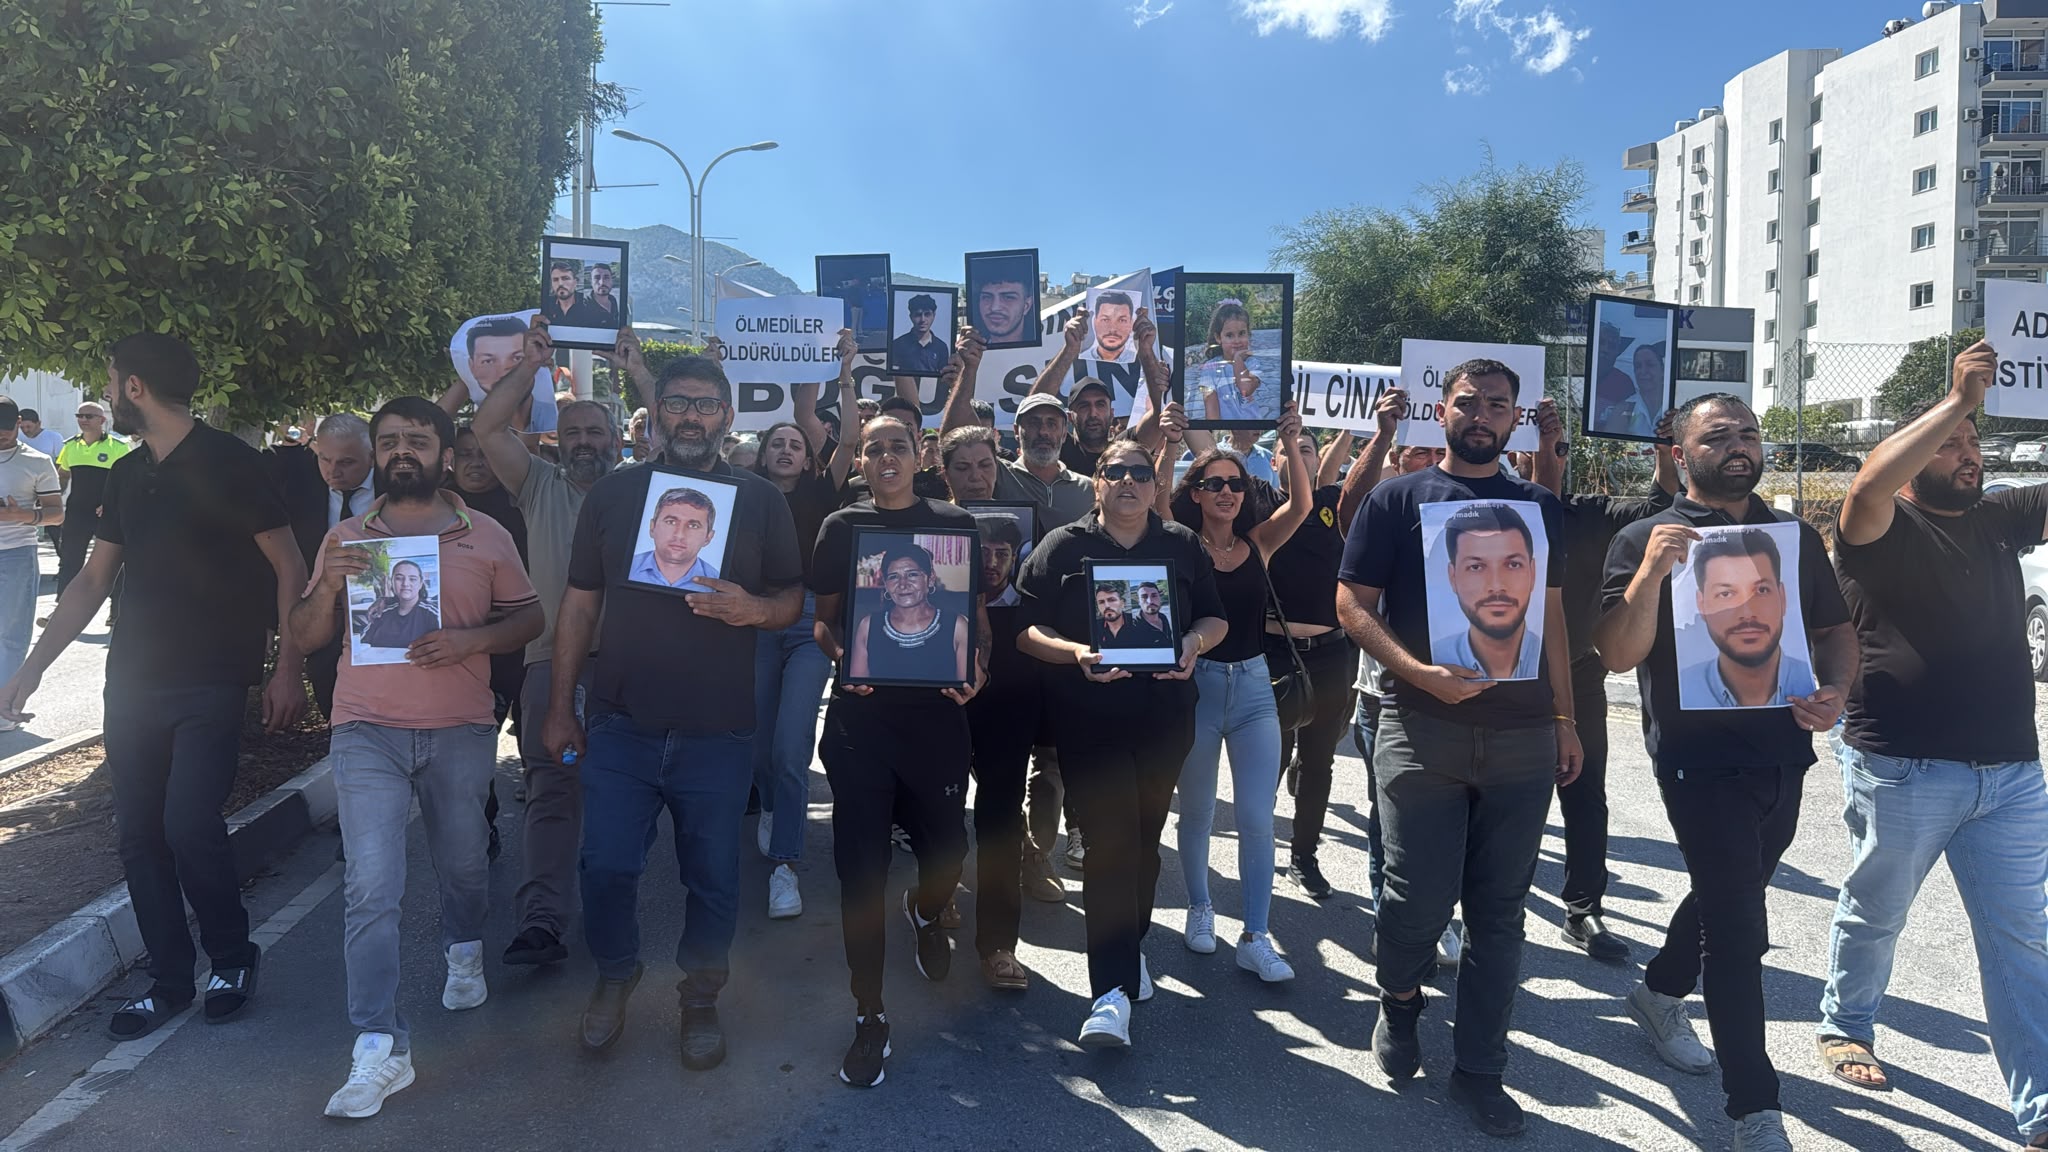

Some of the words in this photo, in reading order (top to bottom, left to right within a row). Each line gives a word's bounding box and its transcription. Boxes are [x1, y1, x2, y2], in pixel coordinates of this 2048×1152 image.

[735, 314, 824, 334] ÖLMEDİLER
[719, 341, 841, 362] ÖLDÜRÜLDÜLER
[1992, 352, 2048, 389] İSTİ
[1291, 365, 1316, 416] İL
[1325, 368, 1395, 420] CİNA
